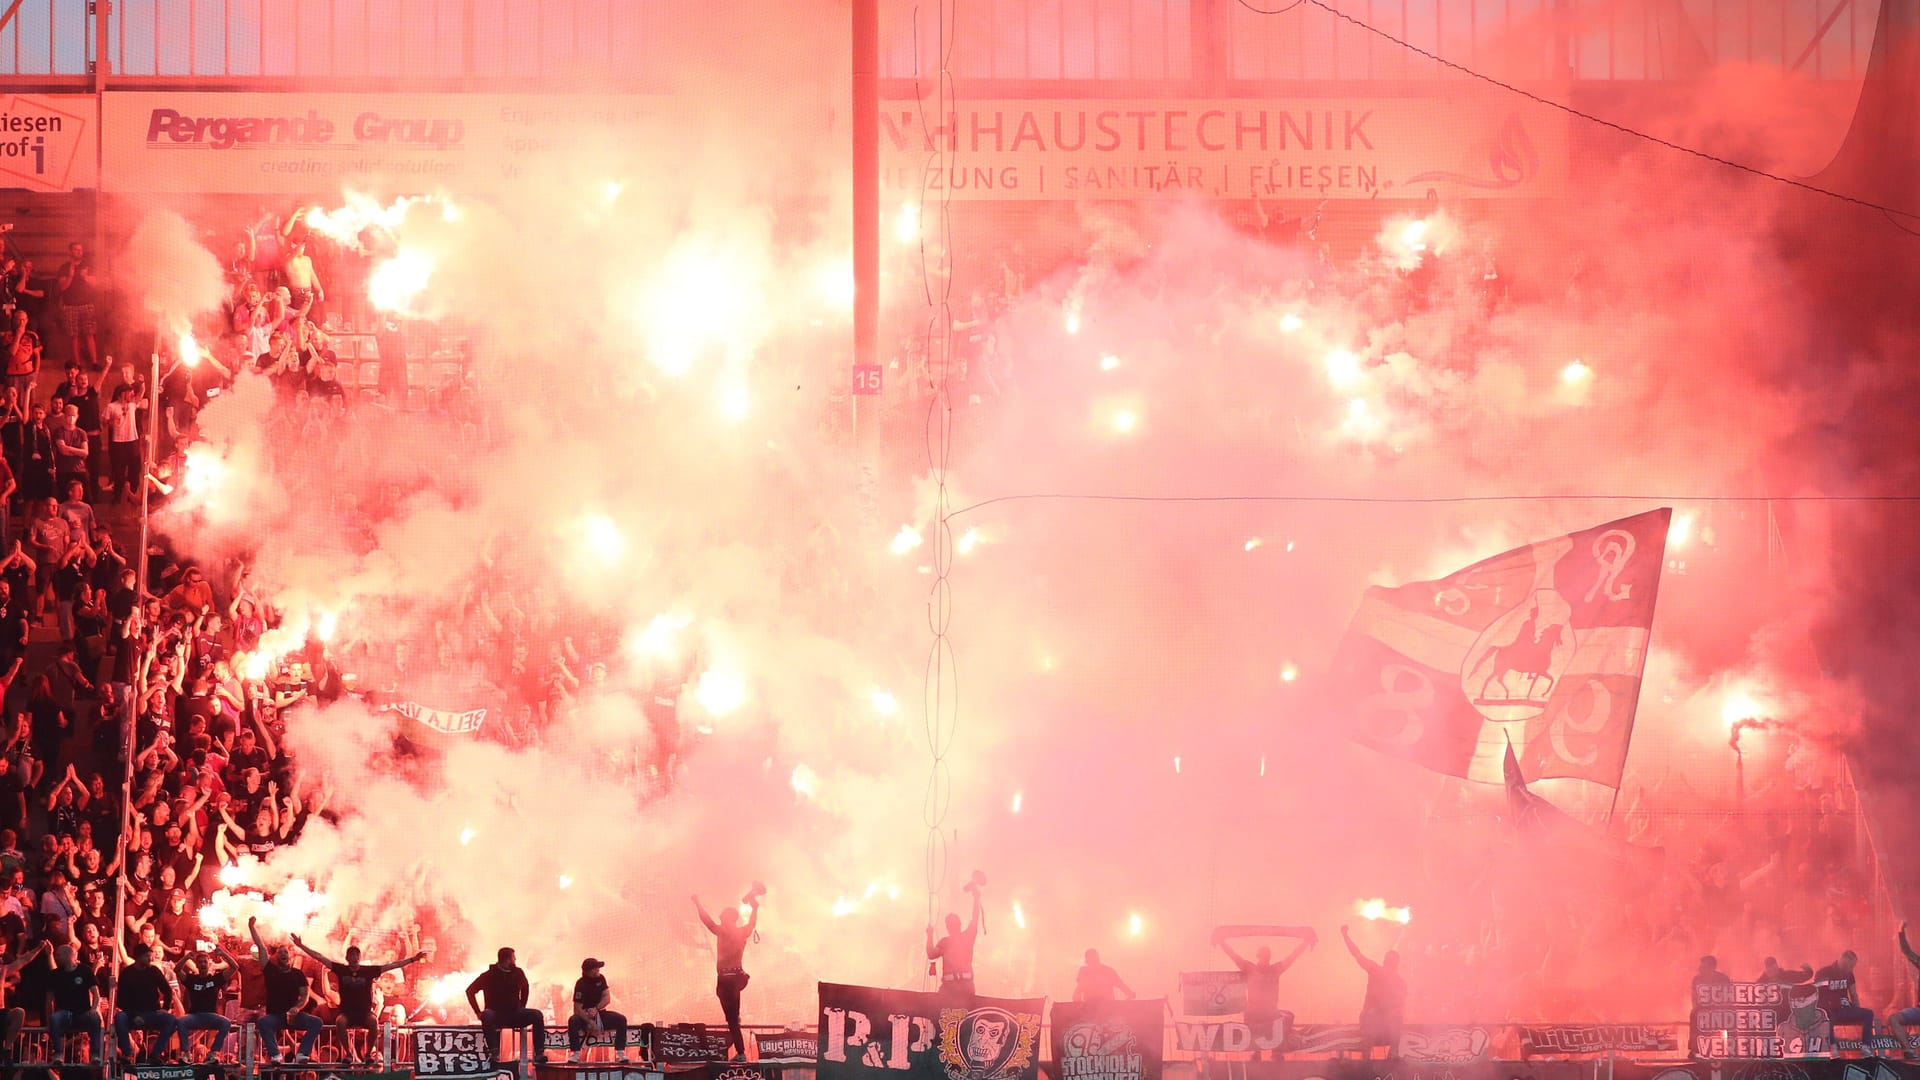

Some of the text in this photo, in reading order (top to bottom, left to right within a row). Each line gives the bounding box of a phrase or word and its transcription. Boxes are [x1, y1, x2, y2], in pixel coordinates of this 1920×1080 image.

[147, 108, 334, 150] Pergande
[353, 112, 465, 149] Group
[0, 136, 45, 174] rofi
[1065, 160, 1203, 190] SANITÄR
[1250, 165, 1378, 190] FLIESEN
[855, 370, 880, 389] 15
[1697, 984, 1780, 1004] SCHEISS
[1698, 1010, 1774, 1030] ANDERE
[1176, 1017, 1284, 1051] WDJ
[1698, 1037, 1784, 1058] VEREINE
[137, 1068, 193, 1080] rote kurve
[1061, 1055, 1139, 1076] STOCKHOLM
